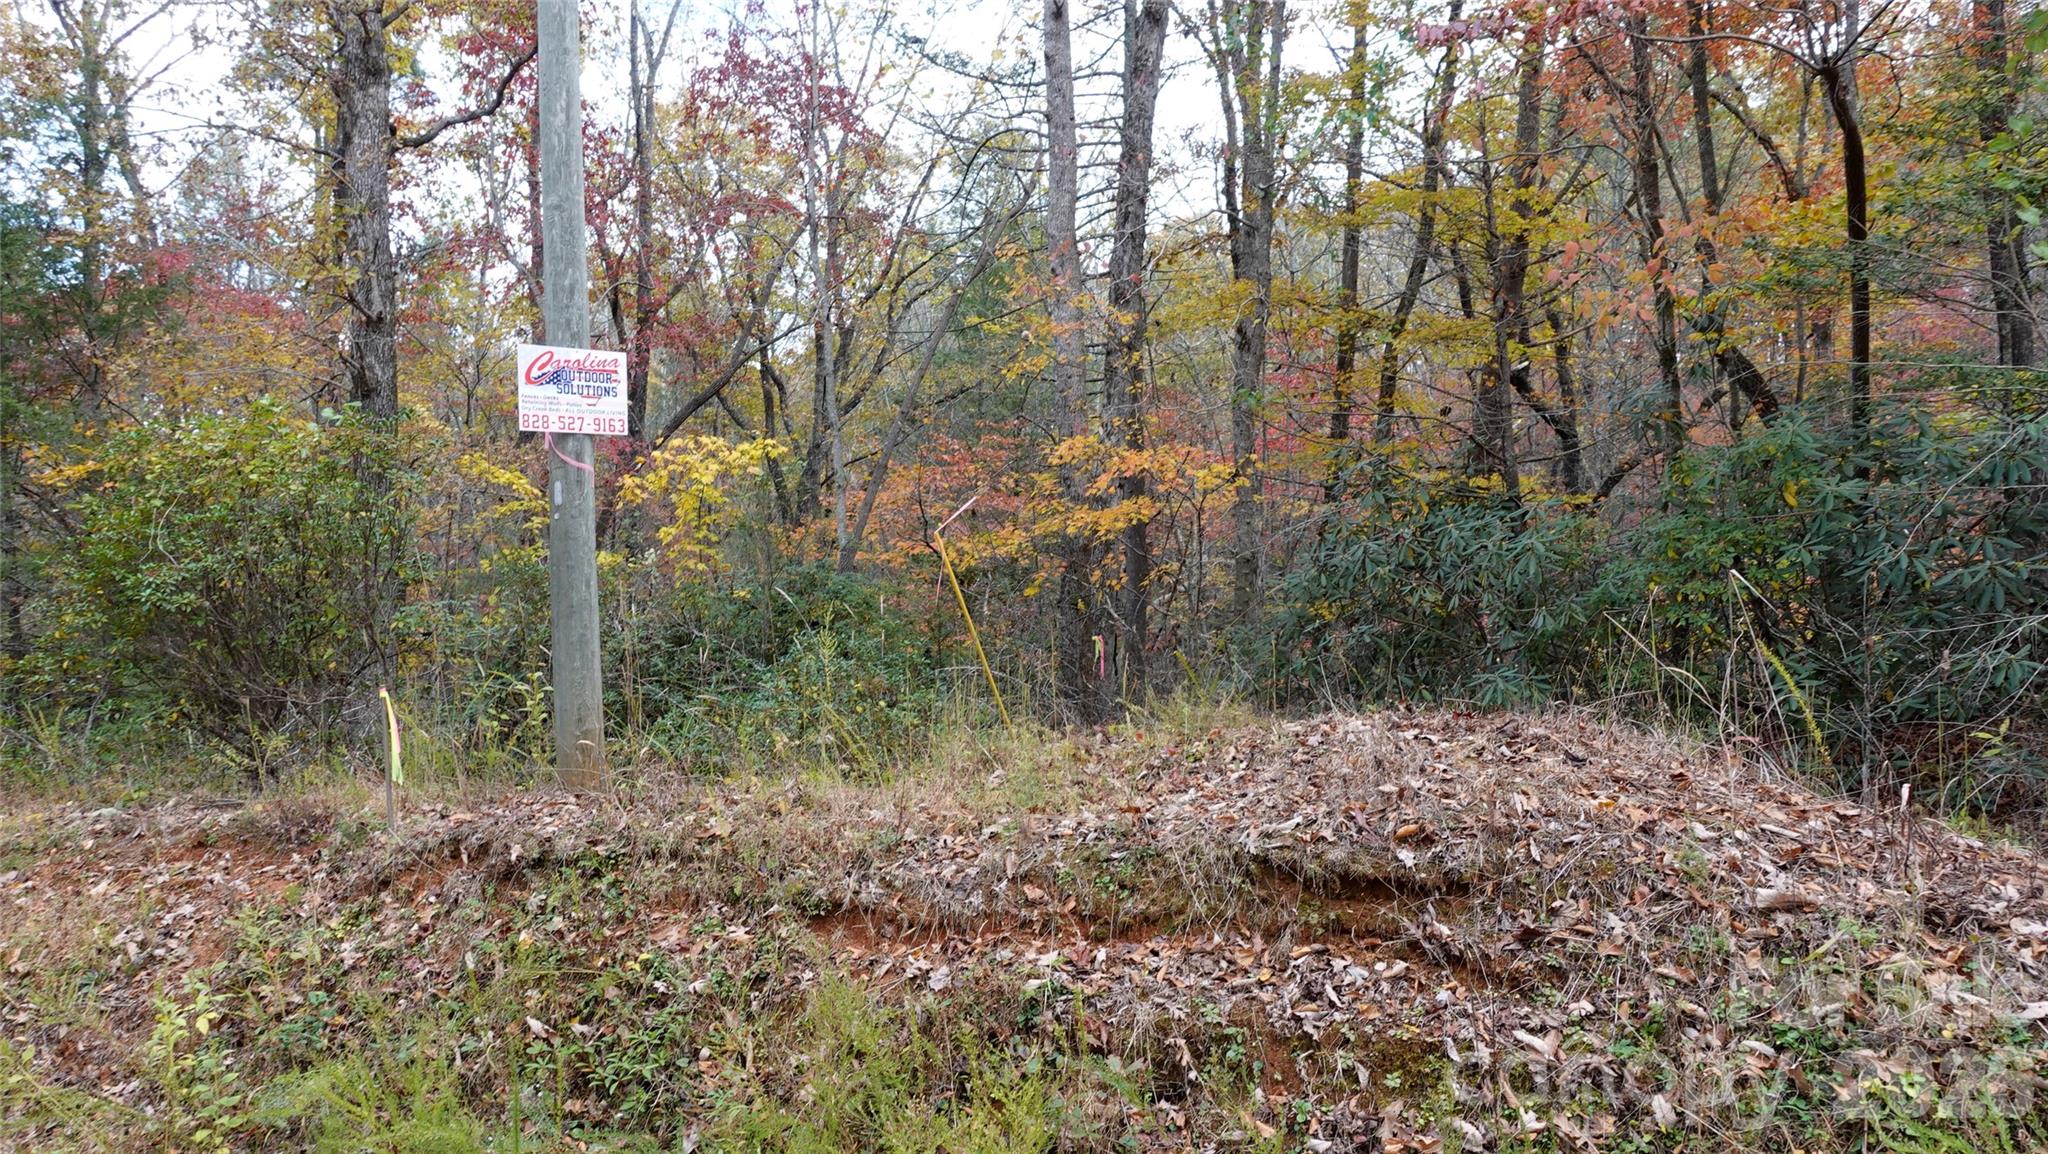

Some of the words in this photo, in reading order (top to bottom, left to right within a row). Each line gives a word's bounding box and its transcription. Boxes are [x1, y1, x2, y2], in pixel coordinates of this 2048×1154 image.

[525, 351, 620, 385] Carolina
[561, 370, 612, 384] OUTDOOR
[557, 384, 617, 397] SOLUTIONS
[522, 414, 625, 433] 828-527-9163
